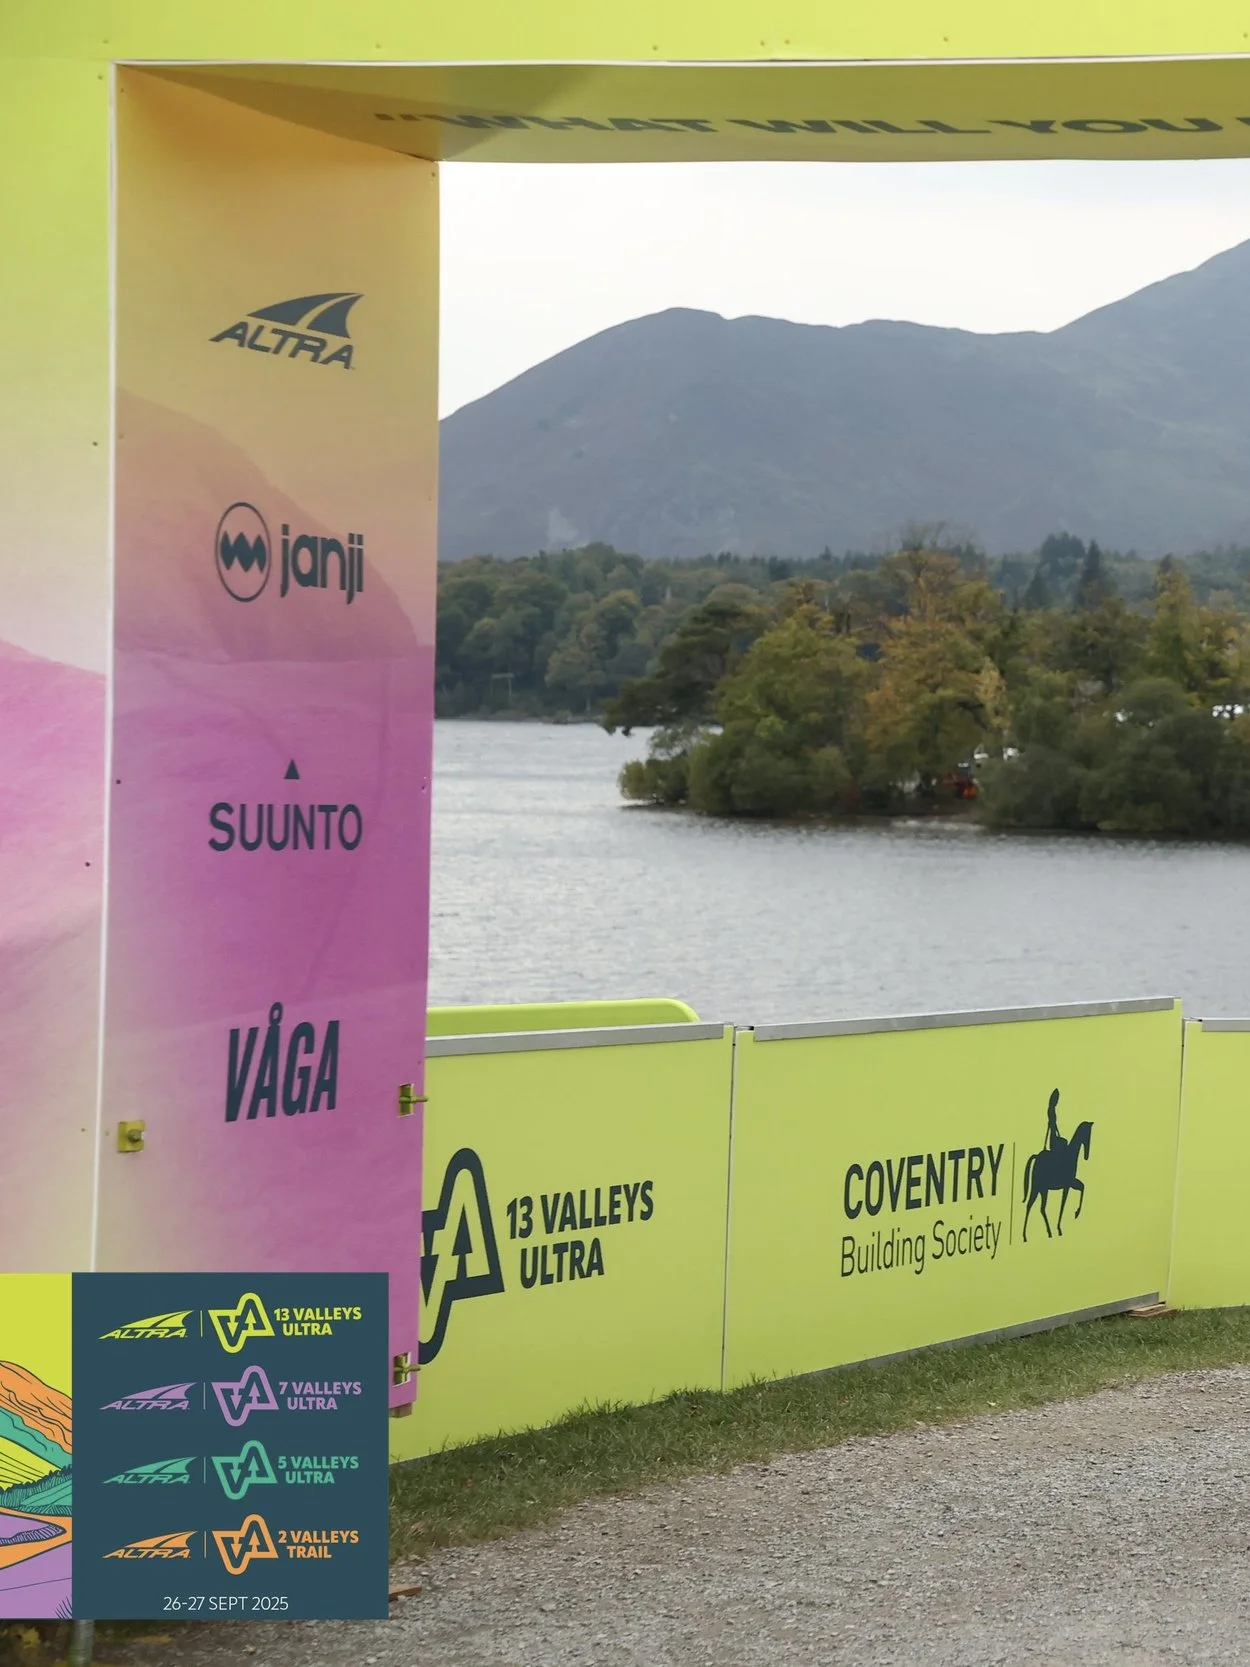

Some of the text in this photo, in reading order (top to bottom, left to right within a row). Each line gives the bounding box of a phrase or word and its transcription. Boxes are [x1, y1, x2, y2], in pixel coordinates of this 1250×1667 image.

[373, 111, 722, 134] "WHAT
[726, 117, 992, 135] WILL
[984, 117, 1224, 135] YOU
[209, 321, 353, 369] ALTRA
[279, 523, 365, 606] janji
[207, 802, 364, 852] SUUNTO
[224, 1001, 341, 1123] VÅGA
[506, 1179, 654, 1240] 13 VALLEYS
[843, 1143, 1005, 1220] COVENTRY
[520, 1237, 605, 1289] ULTRA
[840, 1214, 1002, 1277] Building Society
